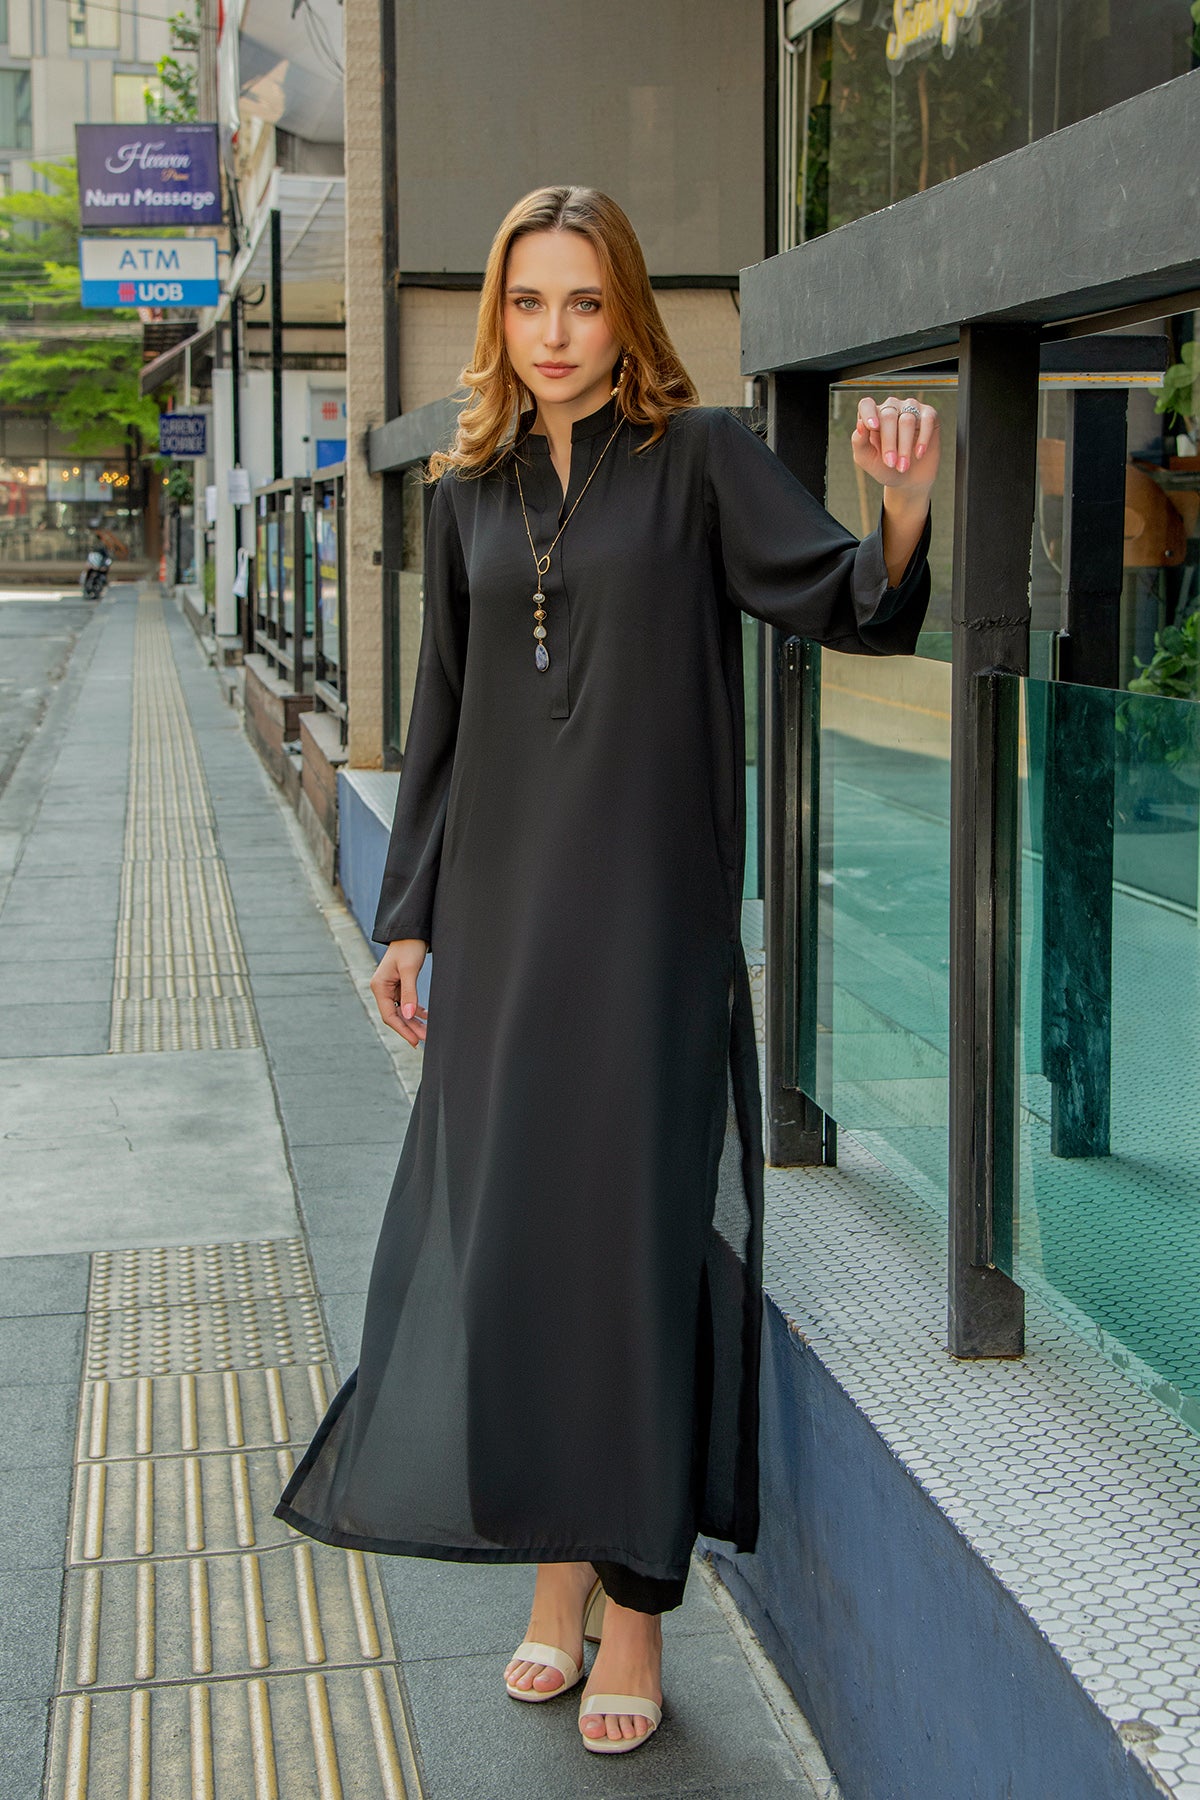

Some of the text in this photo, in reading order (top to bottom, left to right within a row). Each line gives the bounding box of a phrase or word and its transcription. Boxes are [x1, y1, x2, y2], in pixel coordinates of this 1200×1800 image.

[85, 187, 215, 210] Nuru Massage
[119, 249, 180, 270] ATM
[138, 282, 183, 301] UOB
